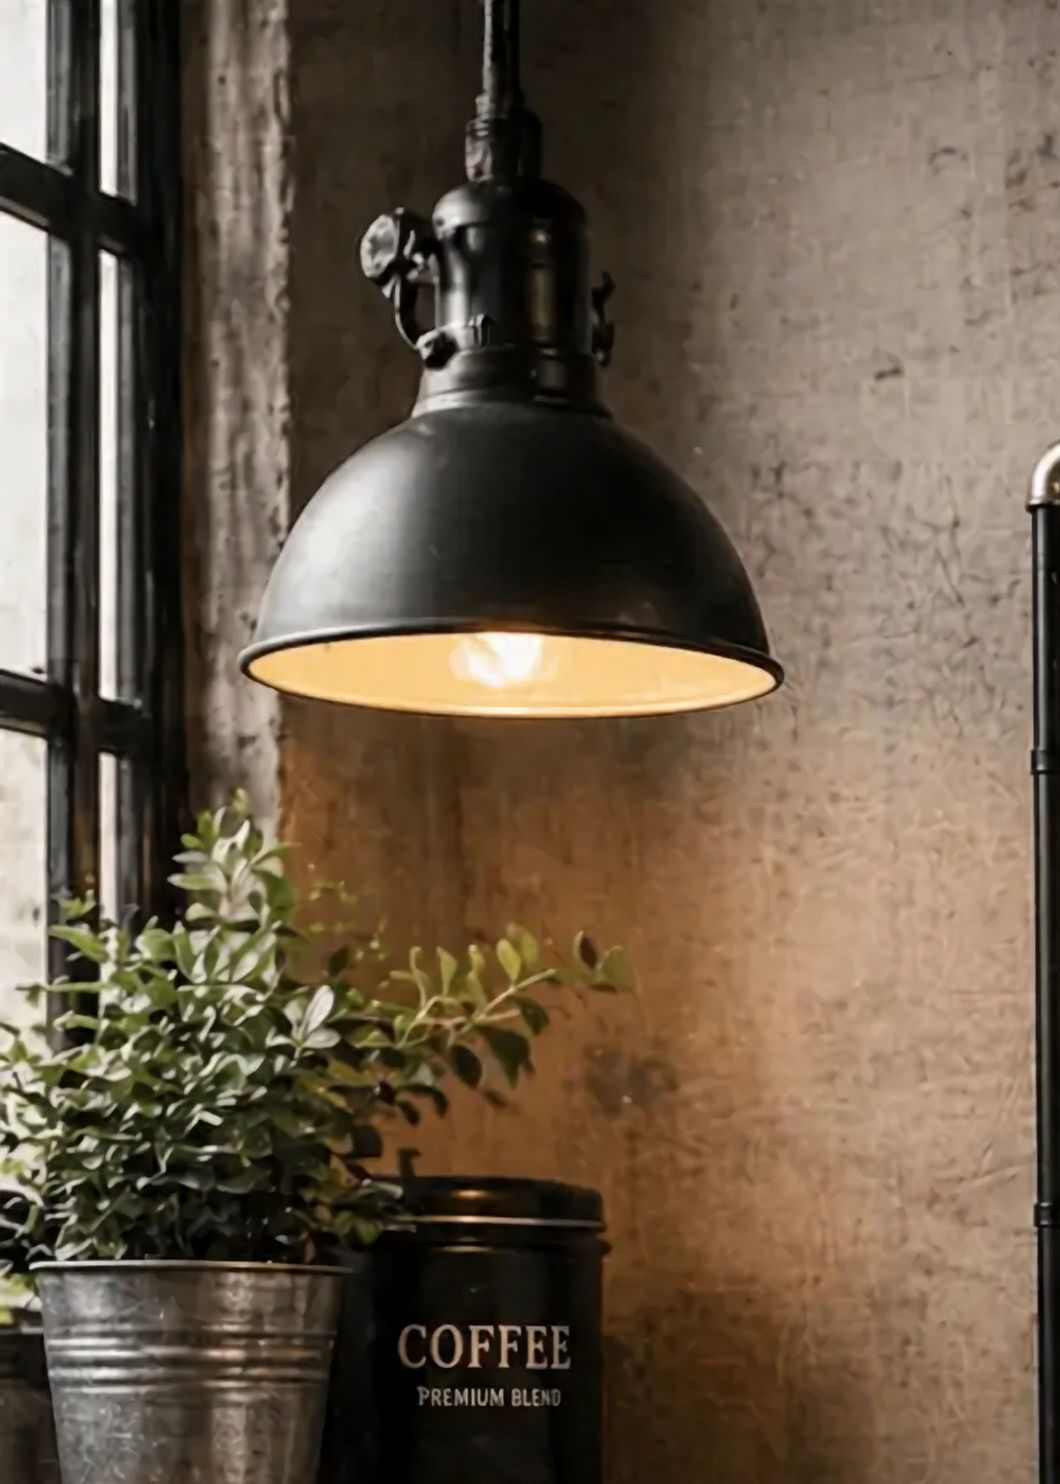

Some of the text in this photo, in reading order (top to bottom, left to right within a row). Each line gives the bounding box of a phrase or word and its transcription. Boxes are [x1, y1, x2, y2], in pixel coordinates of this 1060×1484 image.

[398, 1323, 571, 1369] COFFEE
[417, 1386, 561, 1408] PREMIUM BLEND
